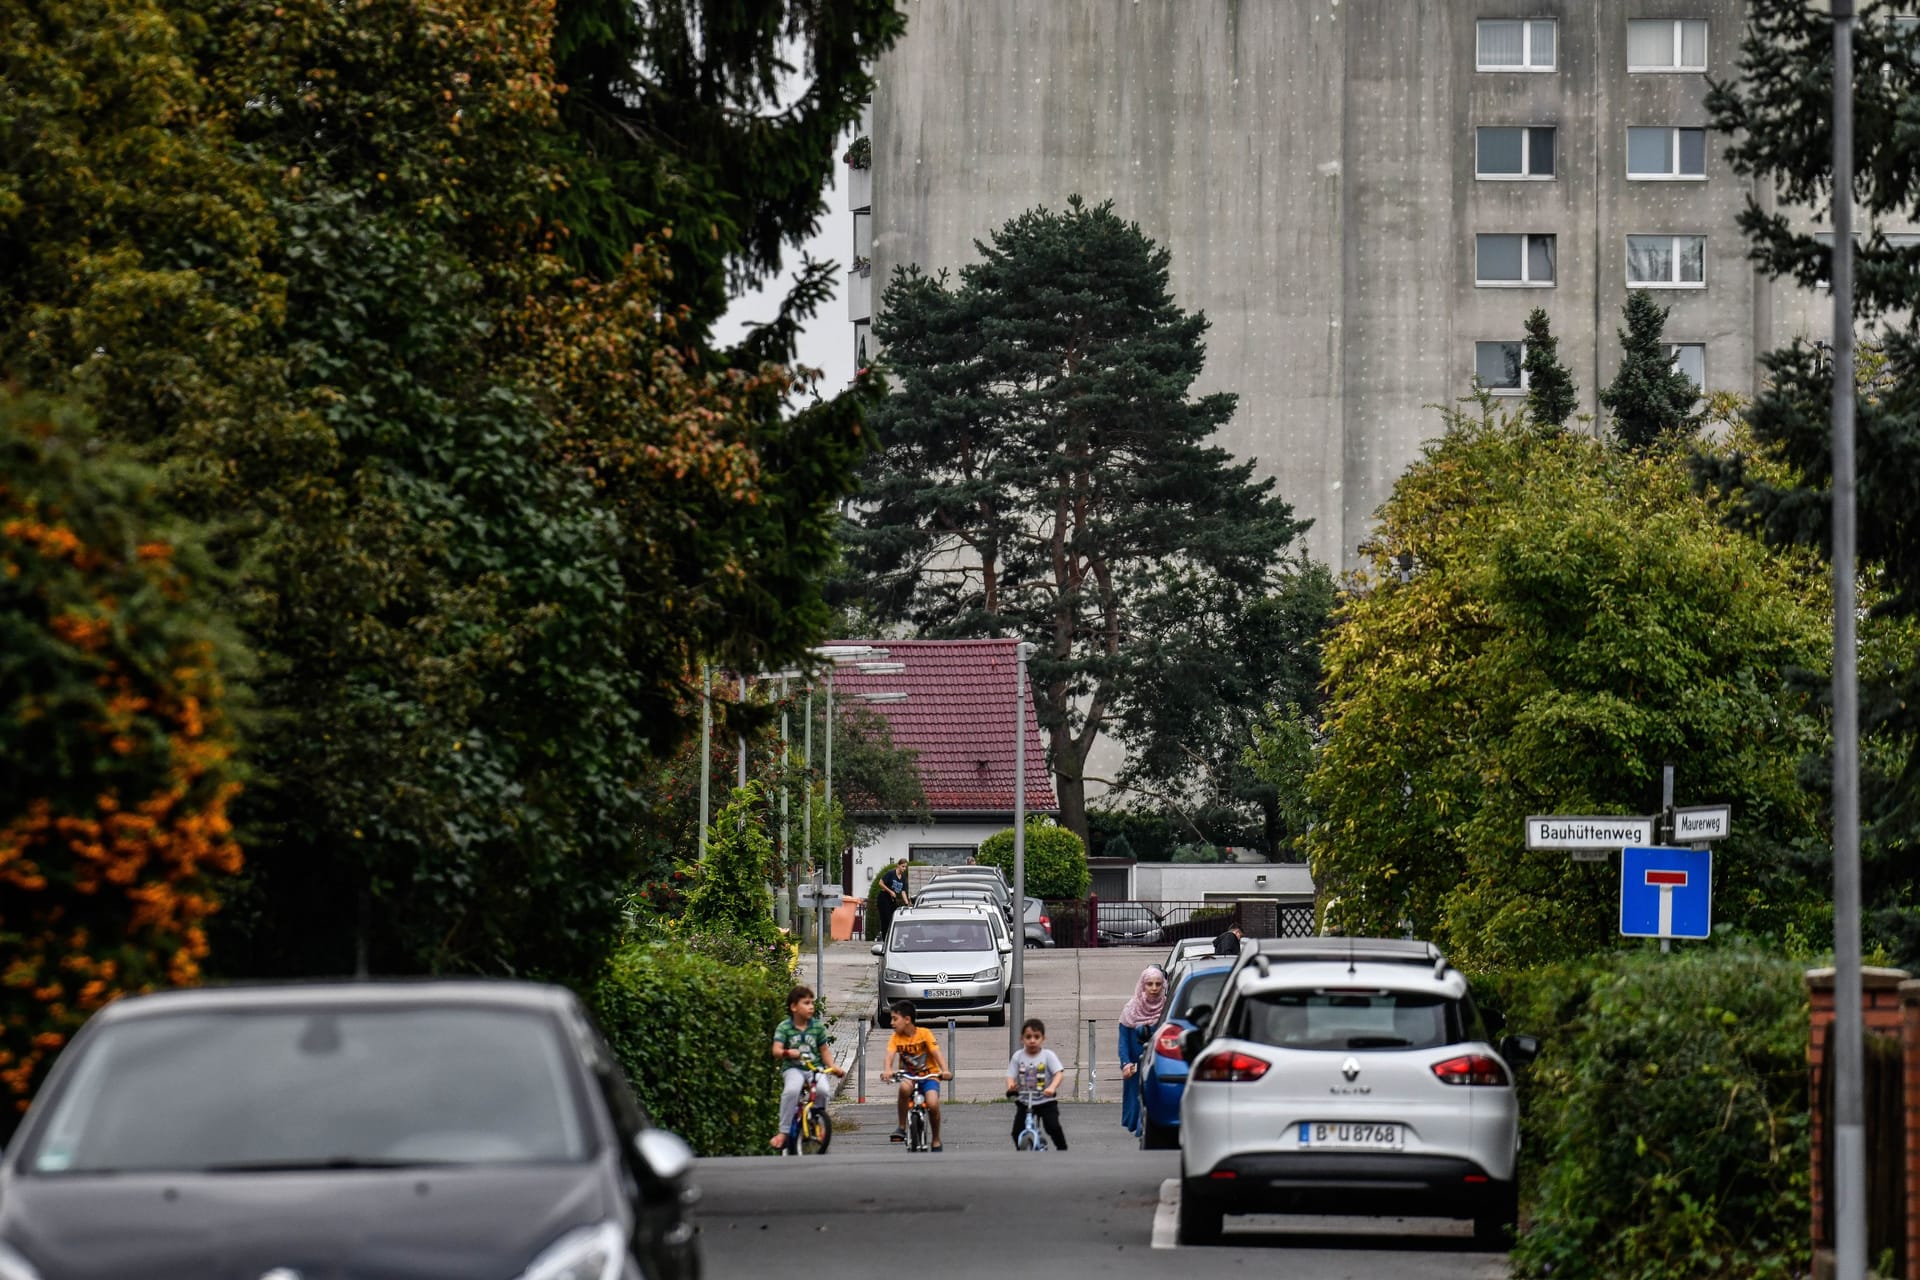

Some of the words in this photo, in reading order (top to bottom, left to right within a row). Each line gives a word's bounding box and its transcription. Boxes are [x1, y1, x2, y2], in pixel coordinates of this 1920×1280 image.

[1540, 823, 1642, 843] Bauhüttenweg
[1681, 815, 1720, 833] Maurerweg
[1316, 1124, 1327, 1141] B
